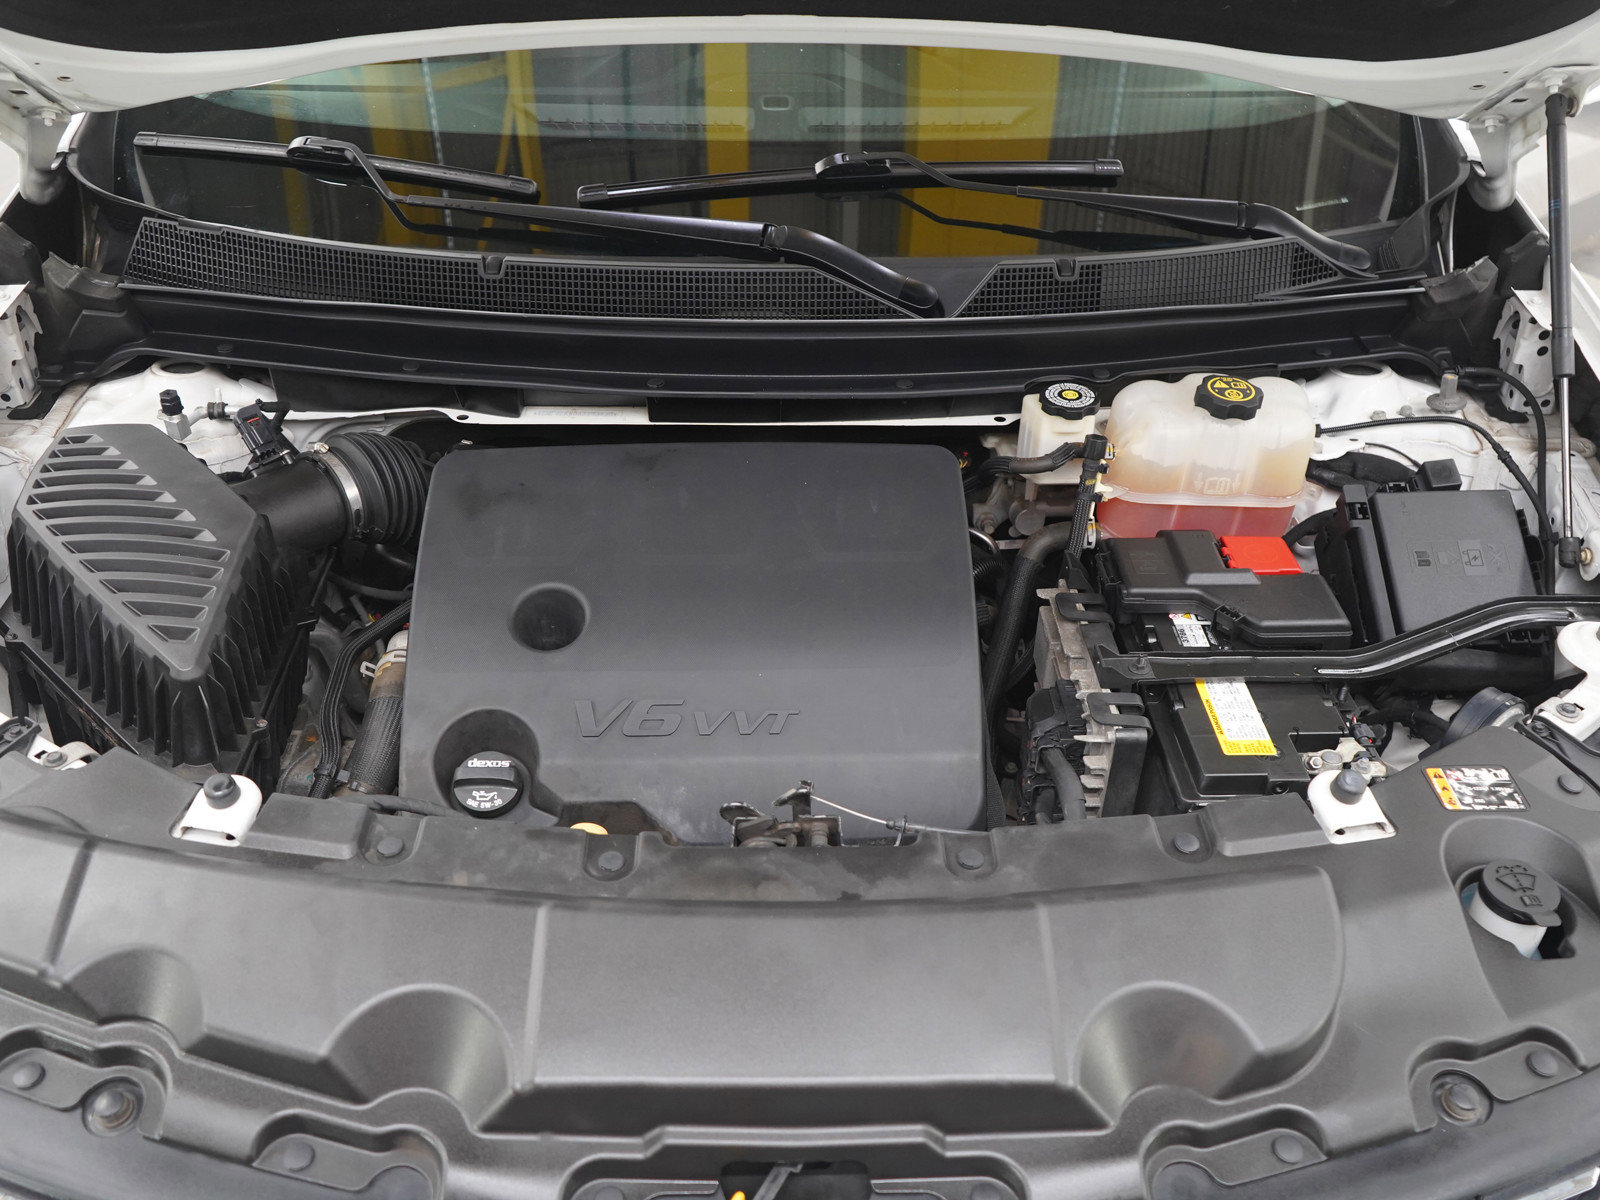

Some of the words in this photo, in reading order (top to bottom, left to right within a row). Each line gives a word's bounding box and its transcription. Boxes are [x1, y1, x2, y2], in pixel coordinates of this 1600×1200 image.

[574, 699, 686, 738] V6
[693, 710, 801, 736] VVT
[467, 758, 511, 768] dexos
[466, 798, 480, 808] SAE
[480, 798, 503, 809] 5W-30
